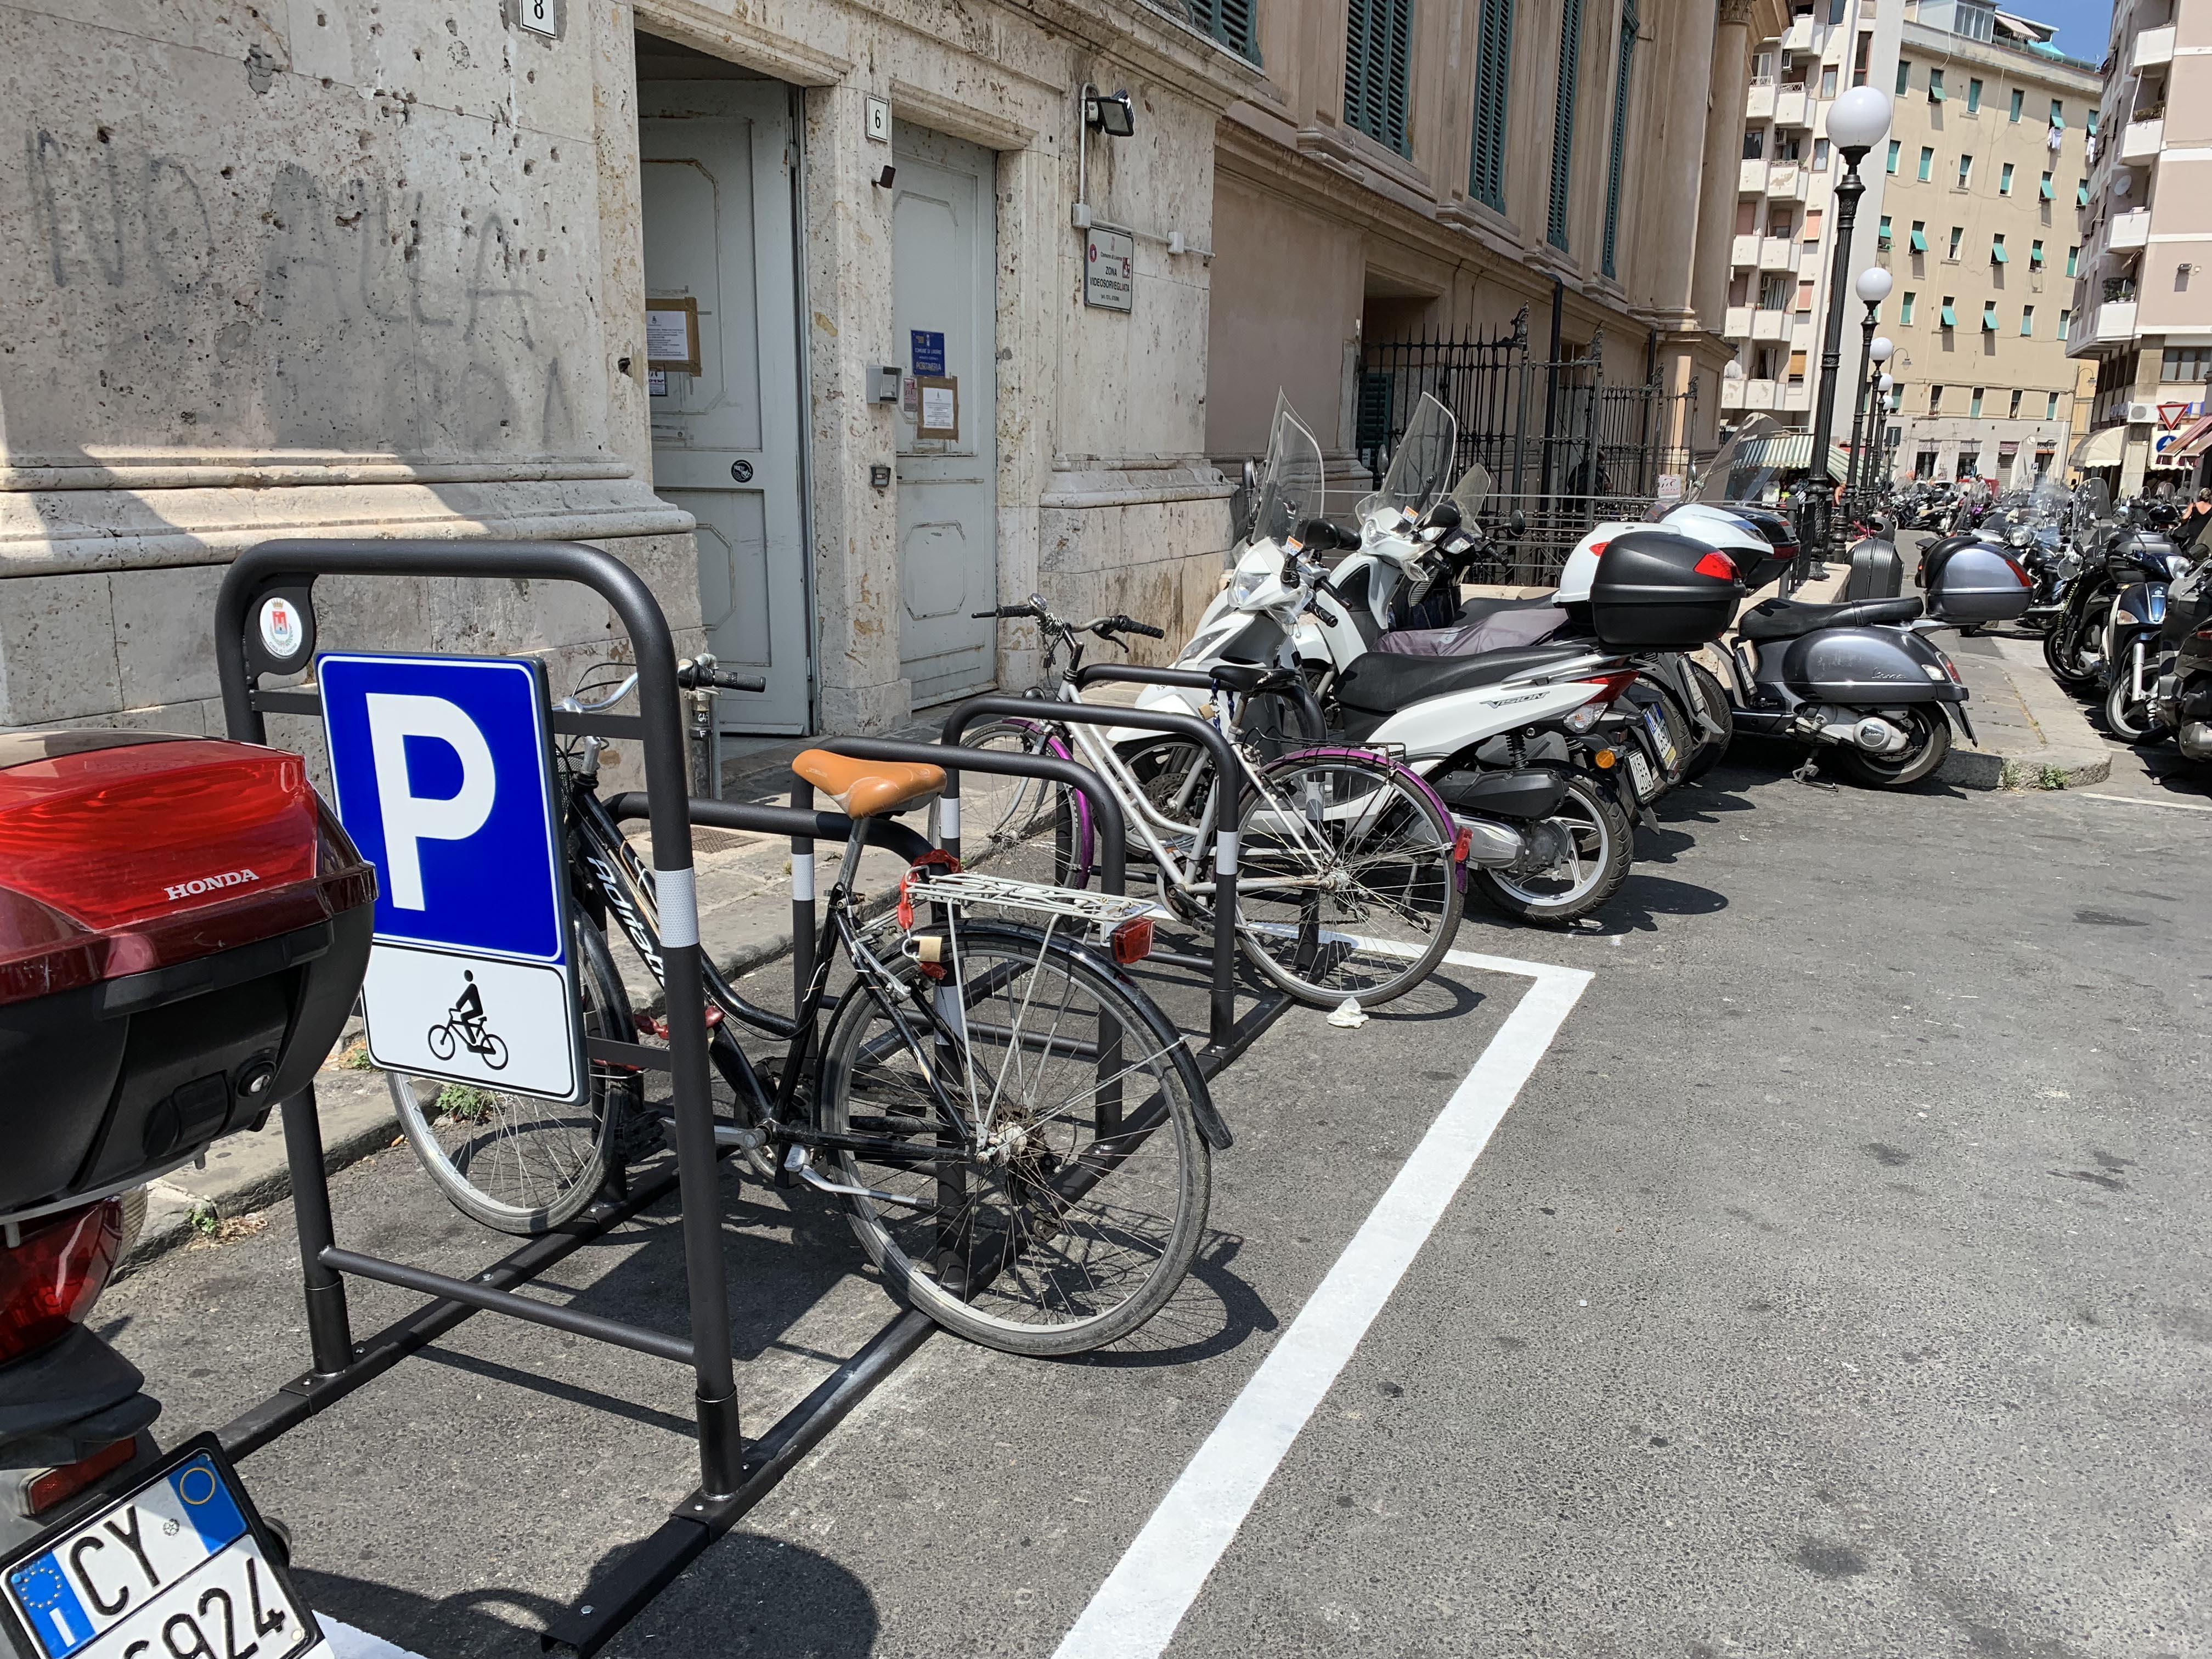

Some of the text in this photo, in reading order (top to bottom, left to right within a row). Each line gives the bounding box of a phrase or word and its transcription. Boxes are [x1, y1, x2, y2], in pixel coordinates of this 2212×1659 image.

[534, 0, 544, 19] 8
[874, 109, 881, 129] 6
[1105, 266, 1117, 276] ZONA
[1090, 276, 1130, 292] VIDEOSORVEGLIATA
[1479, 691, 1550, 709] VISION
[366, 692, 496, 912] P
[163, 868, 259, 900] HONDA
[70, 1504, 160, 1616] CY
